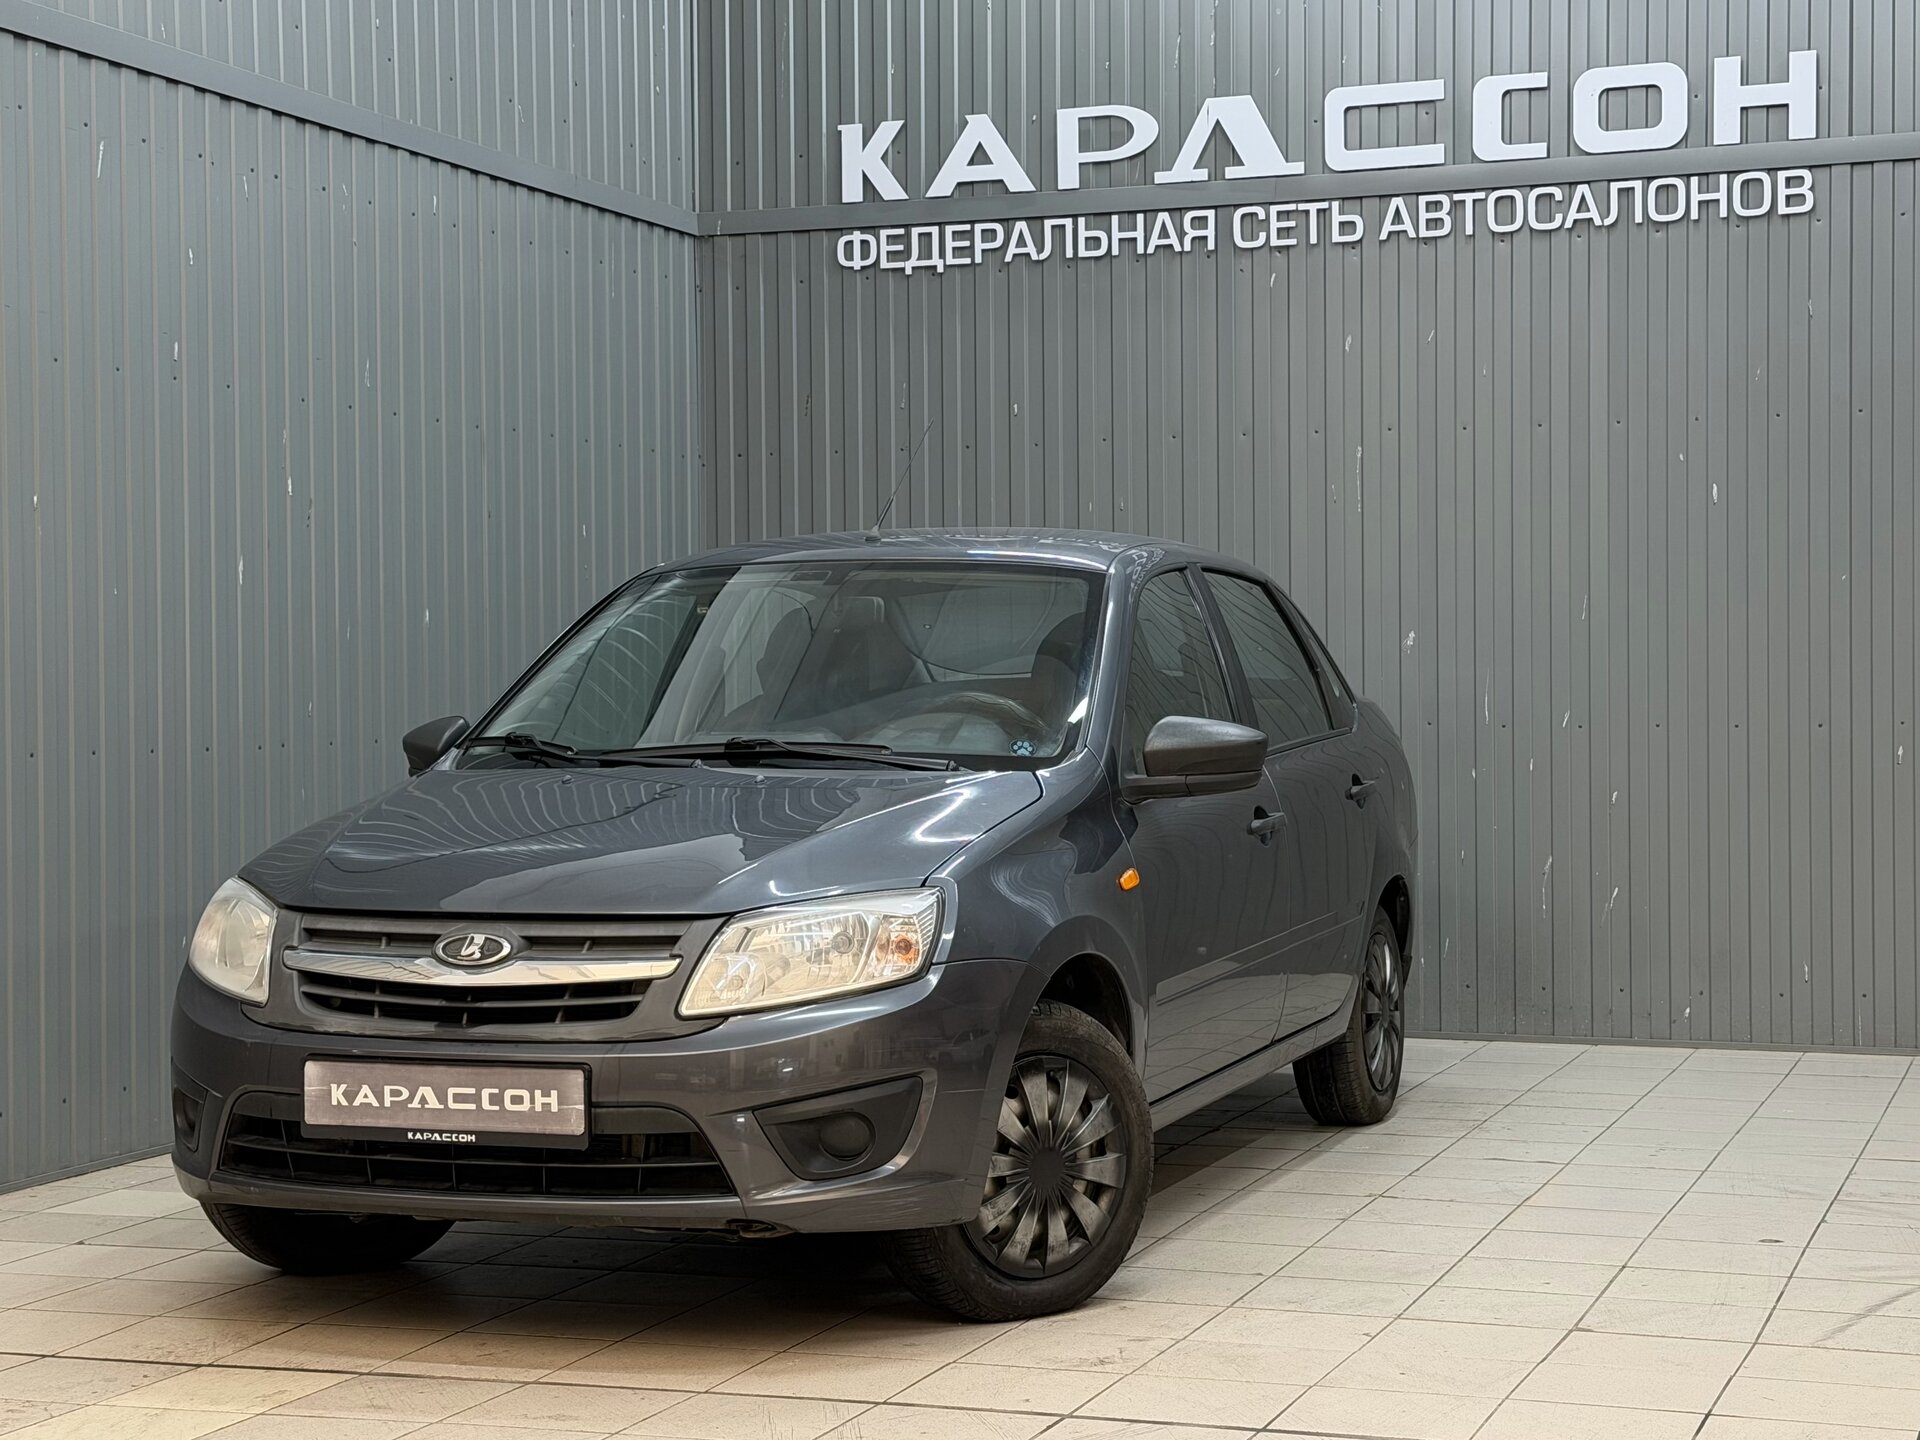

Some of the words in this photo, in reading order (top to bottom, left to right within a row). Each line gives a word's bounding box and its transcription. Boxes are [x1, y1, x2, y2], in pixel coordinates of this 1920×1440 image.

[836, 208, 1217, 275] ФЕДЕРАЛЬНАЯ
[1232, 200, 1365, 249] СЕТЬ
[1378, 168, 1815, 242] АВТОСАЛОНОВ
